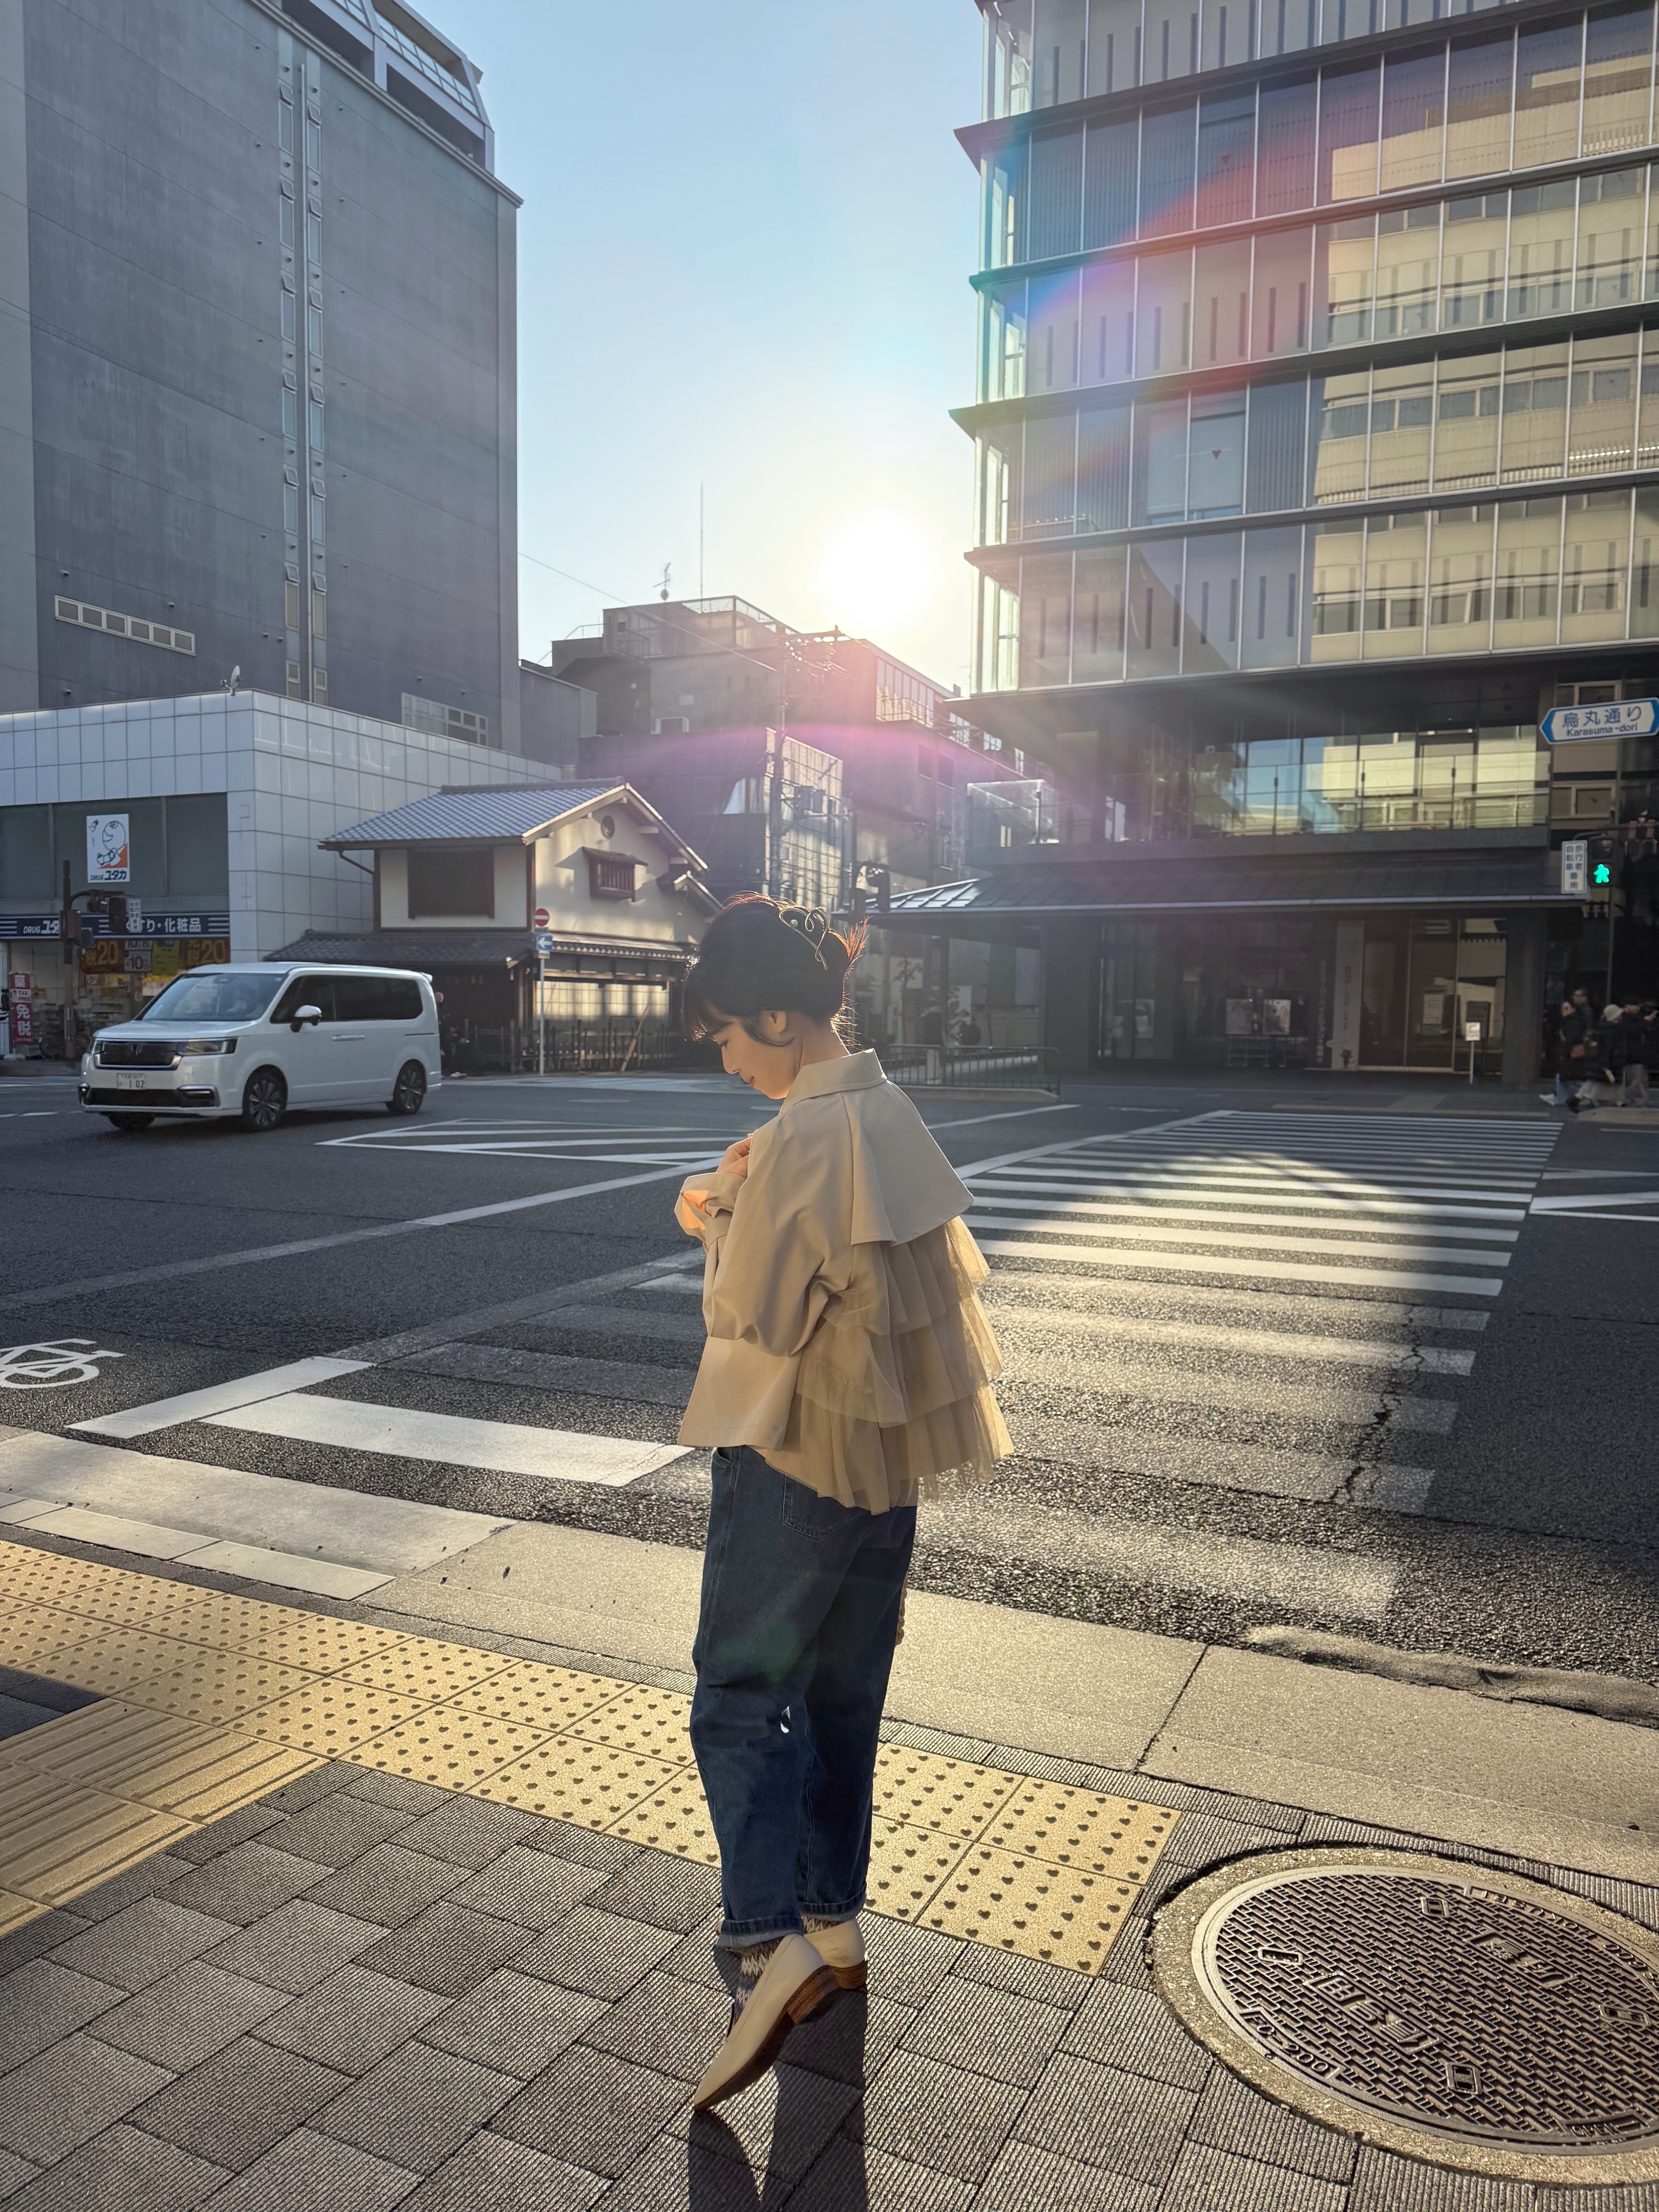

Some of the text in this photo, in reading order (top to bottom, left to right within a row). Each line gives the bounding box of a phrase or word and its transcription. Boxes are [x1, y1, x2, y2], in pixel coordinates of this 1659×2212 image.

[1563, 705, 1642, 728] 烏丸通り
[104, 870, 127, 881] ユタカ
[23, 925, 41, 934] DRUG
[97, 941, 118, 965] 20
[201, 940, 226, 963] 20
